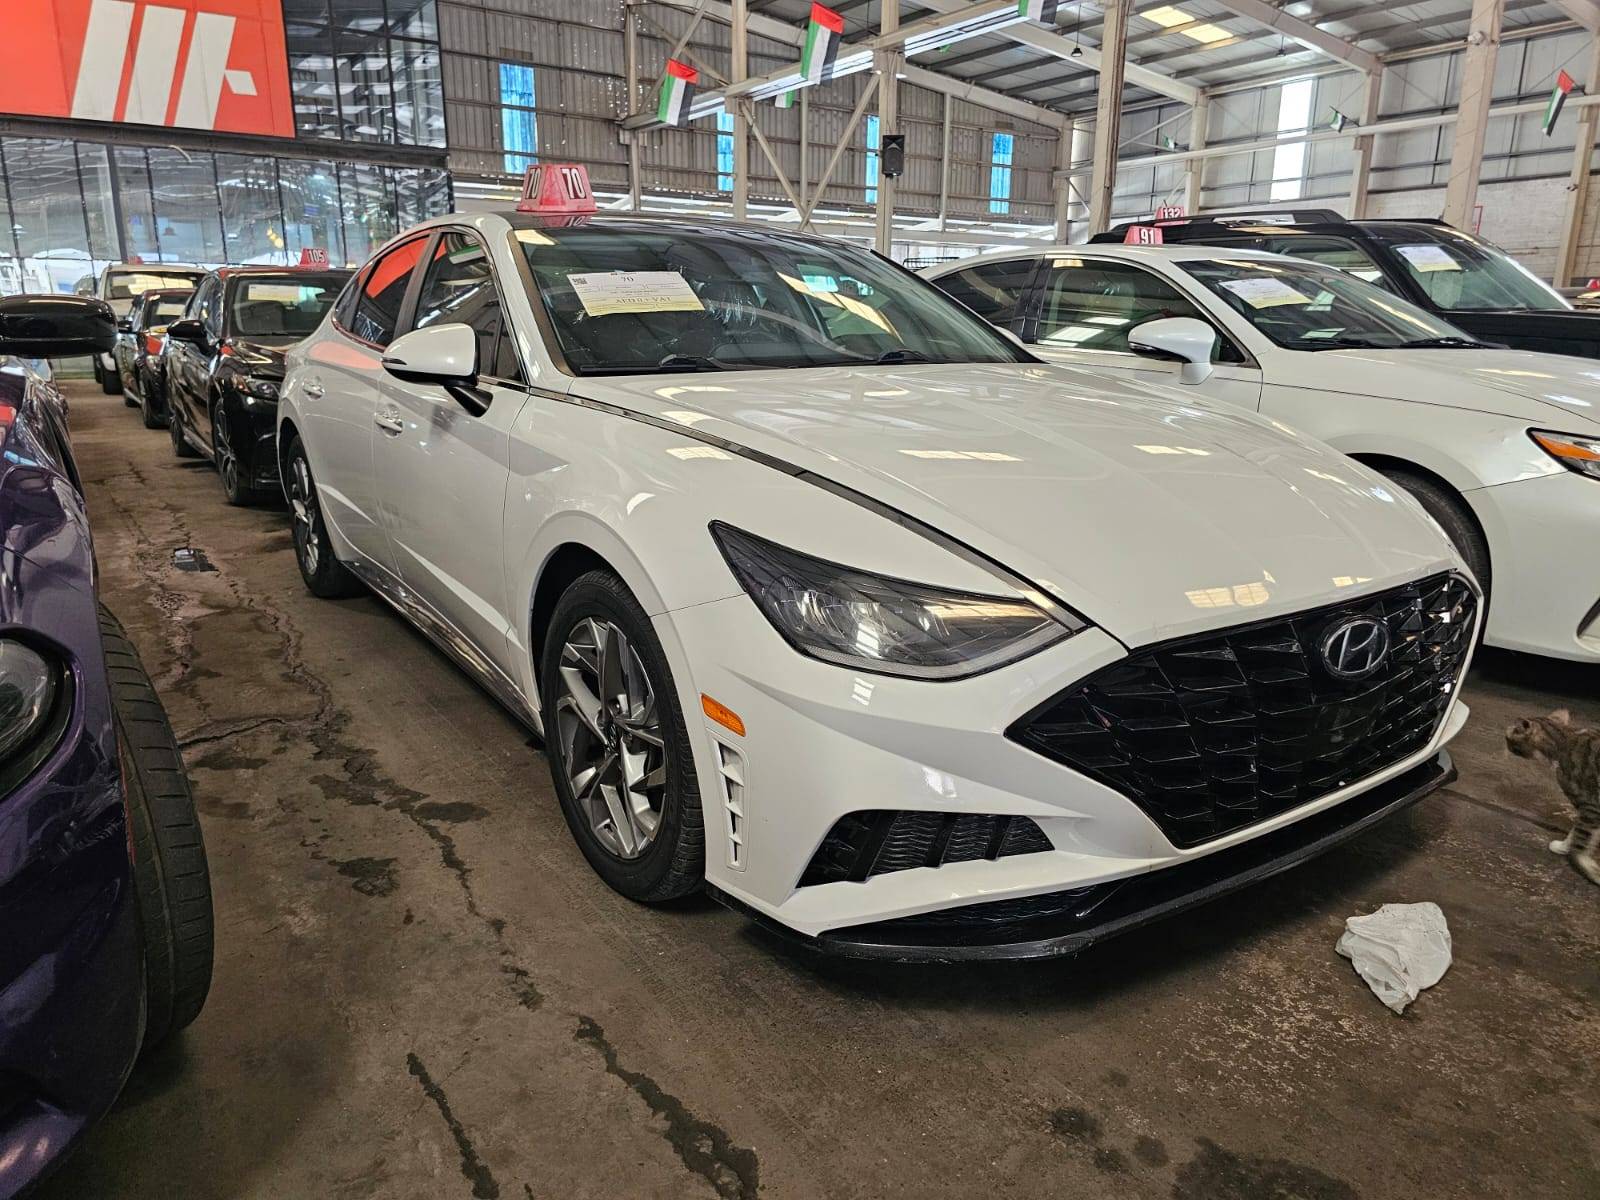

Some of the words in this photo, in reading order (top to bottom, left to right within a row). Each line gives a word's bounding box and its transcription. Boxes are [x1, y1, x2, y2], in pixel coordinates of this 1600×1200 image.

[526, 168, 541, 199] 70
[561, 168, 586, 199] 70
[1163, 208, 1180, 219] 132
[1140, 228, 1155, 245] 91
[309, 249, 325, 263] 105
